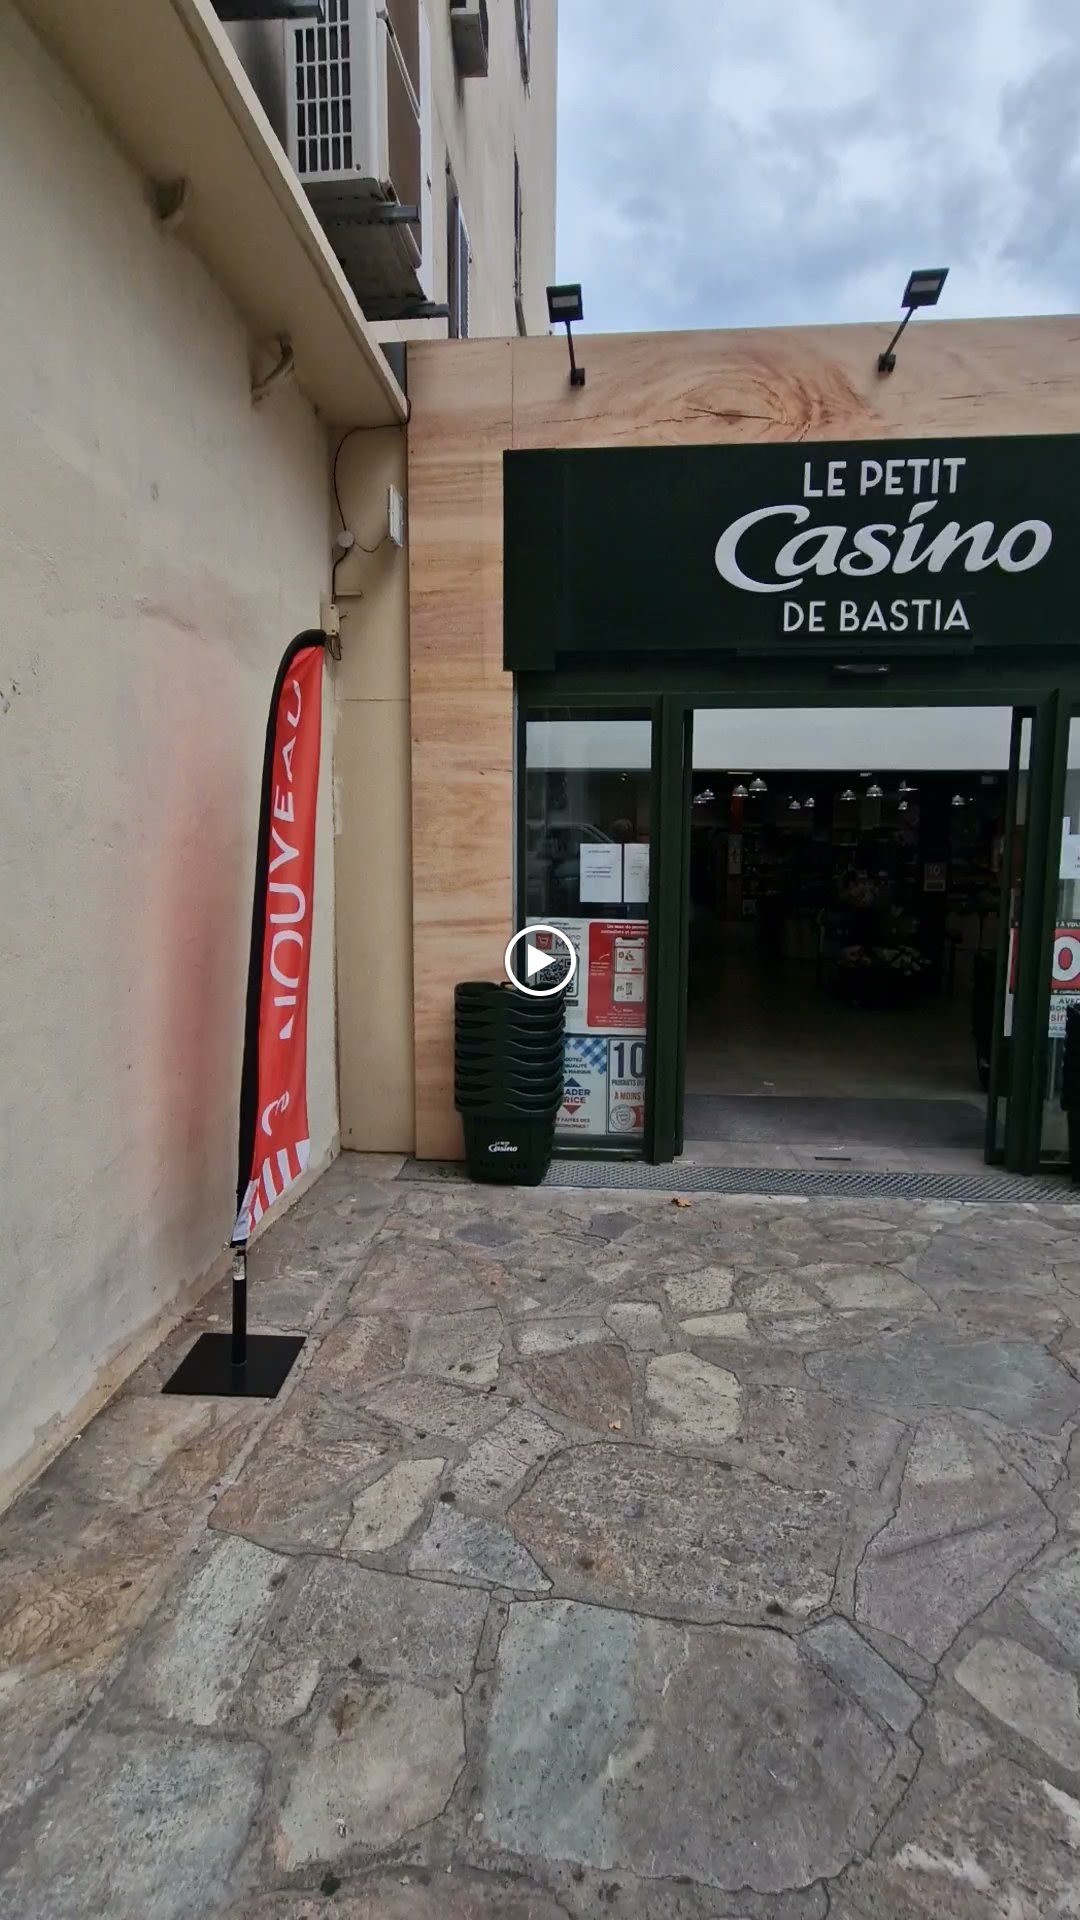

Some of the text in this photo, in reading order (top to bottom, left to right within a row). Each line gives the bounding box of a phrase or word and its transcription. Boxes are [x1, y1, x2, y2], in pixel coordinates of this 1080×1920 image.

[804, 457, 966, 497] LE PETIT
[715, 500, 1052, 593] Casino
[783, 599, 970, 632] DE BASTIA
[614, 1042, 646, 1079] 10
[564, 1088, 591, 1096] ADER
